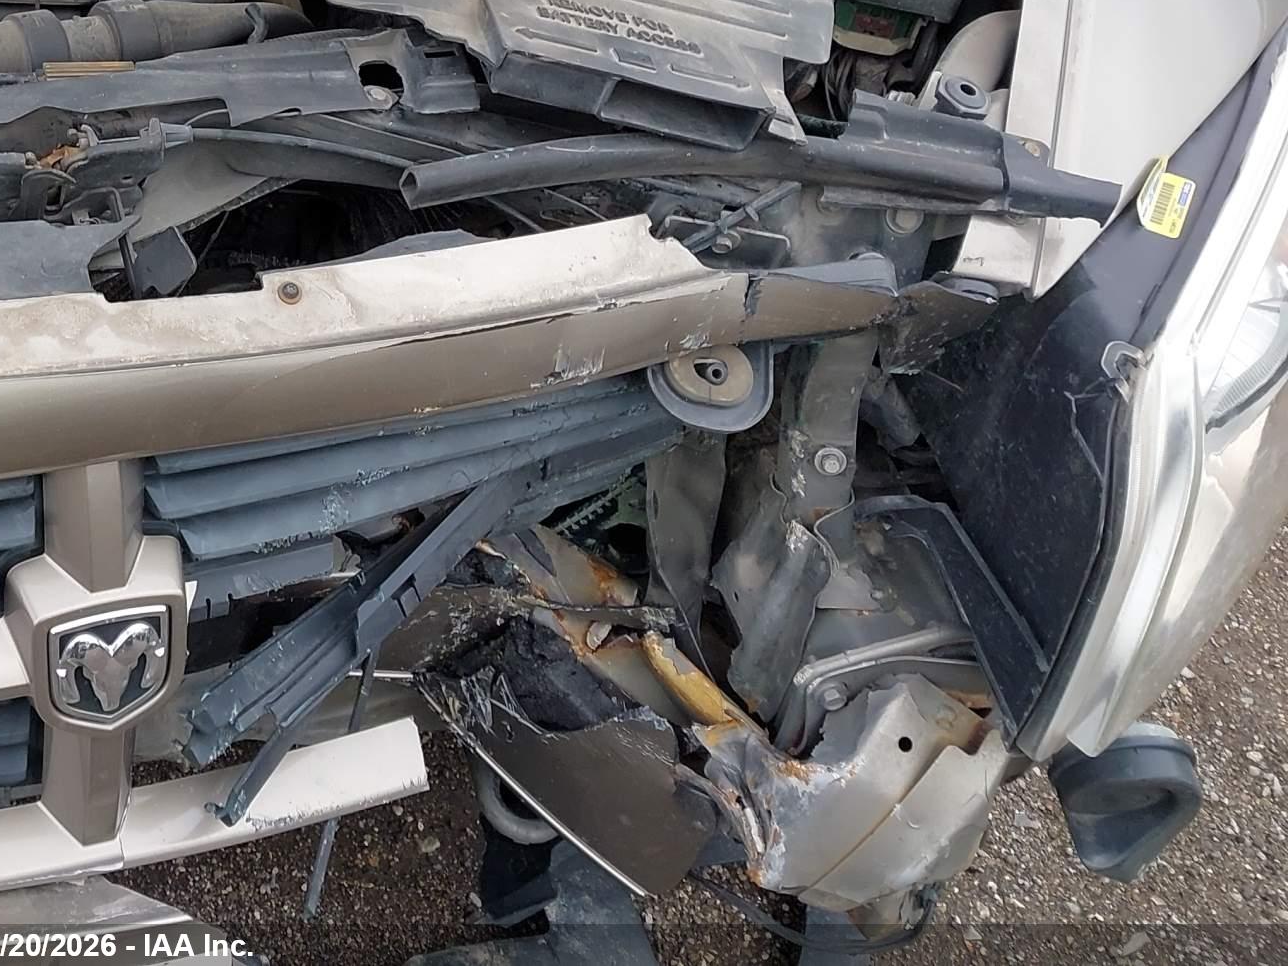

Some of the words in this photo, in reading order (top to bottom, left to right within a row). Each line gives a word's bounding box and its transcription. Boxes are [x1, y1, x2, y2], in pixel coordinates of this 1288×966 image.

[536, 5, 621, 35] BATTERY
[626, 26, 704, 55] ACCESS
[631, 14, 675, 36] FOR
